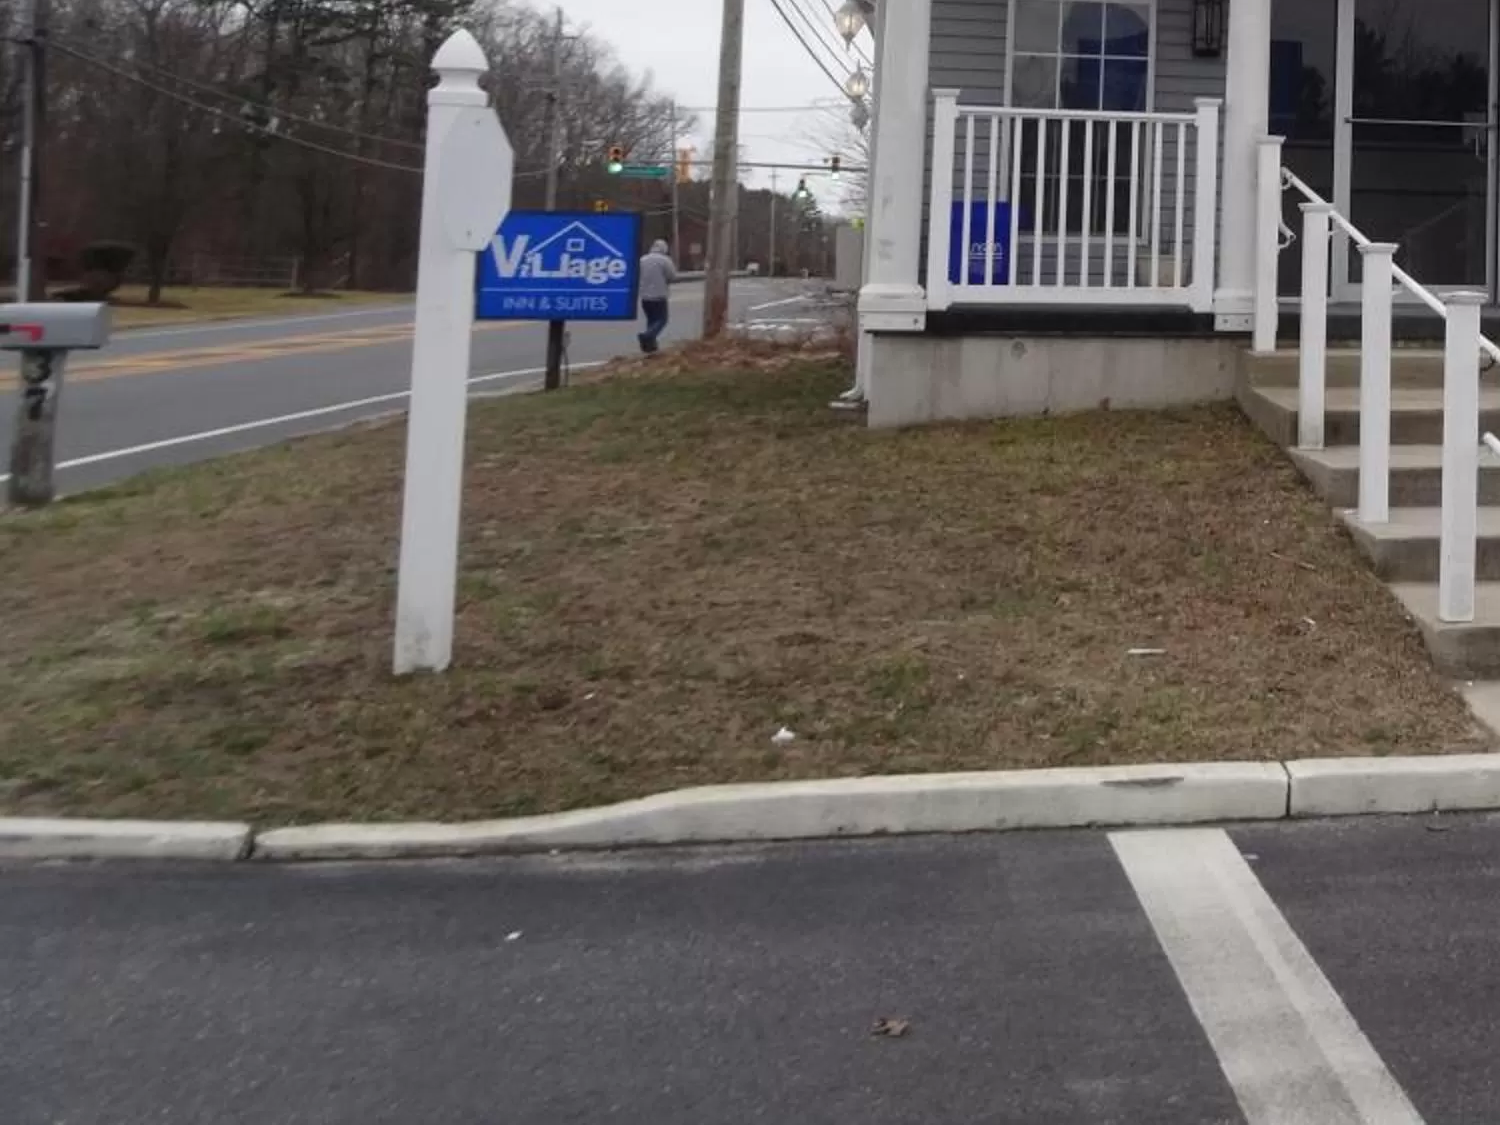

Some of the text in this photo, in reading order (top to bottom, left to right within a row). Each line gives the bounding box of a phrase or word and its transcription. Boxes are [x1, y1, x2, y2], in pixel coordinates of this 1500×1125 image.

[503, 296, 609, 311] INN & SUITES
